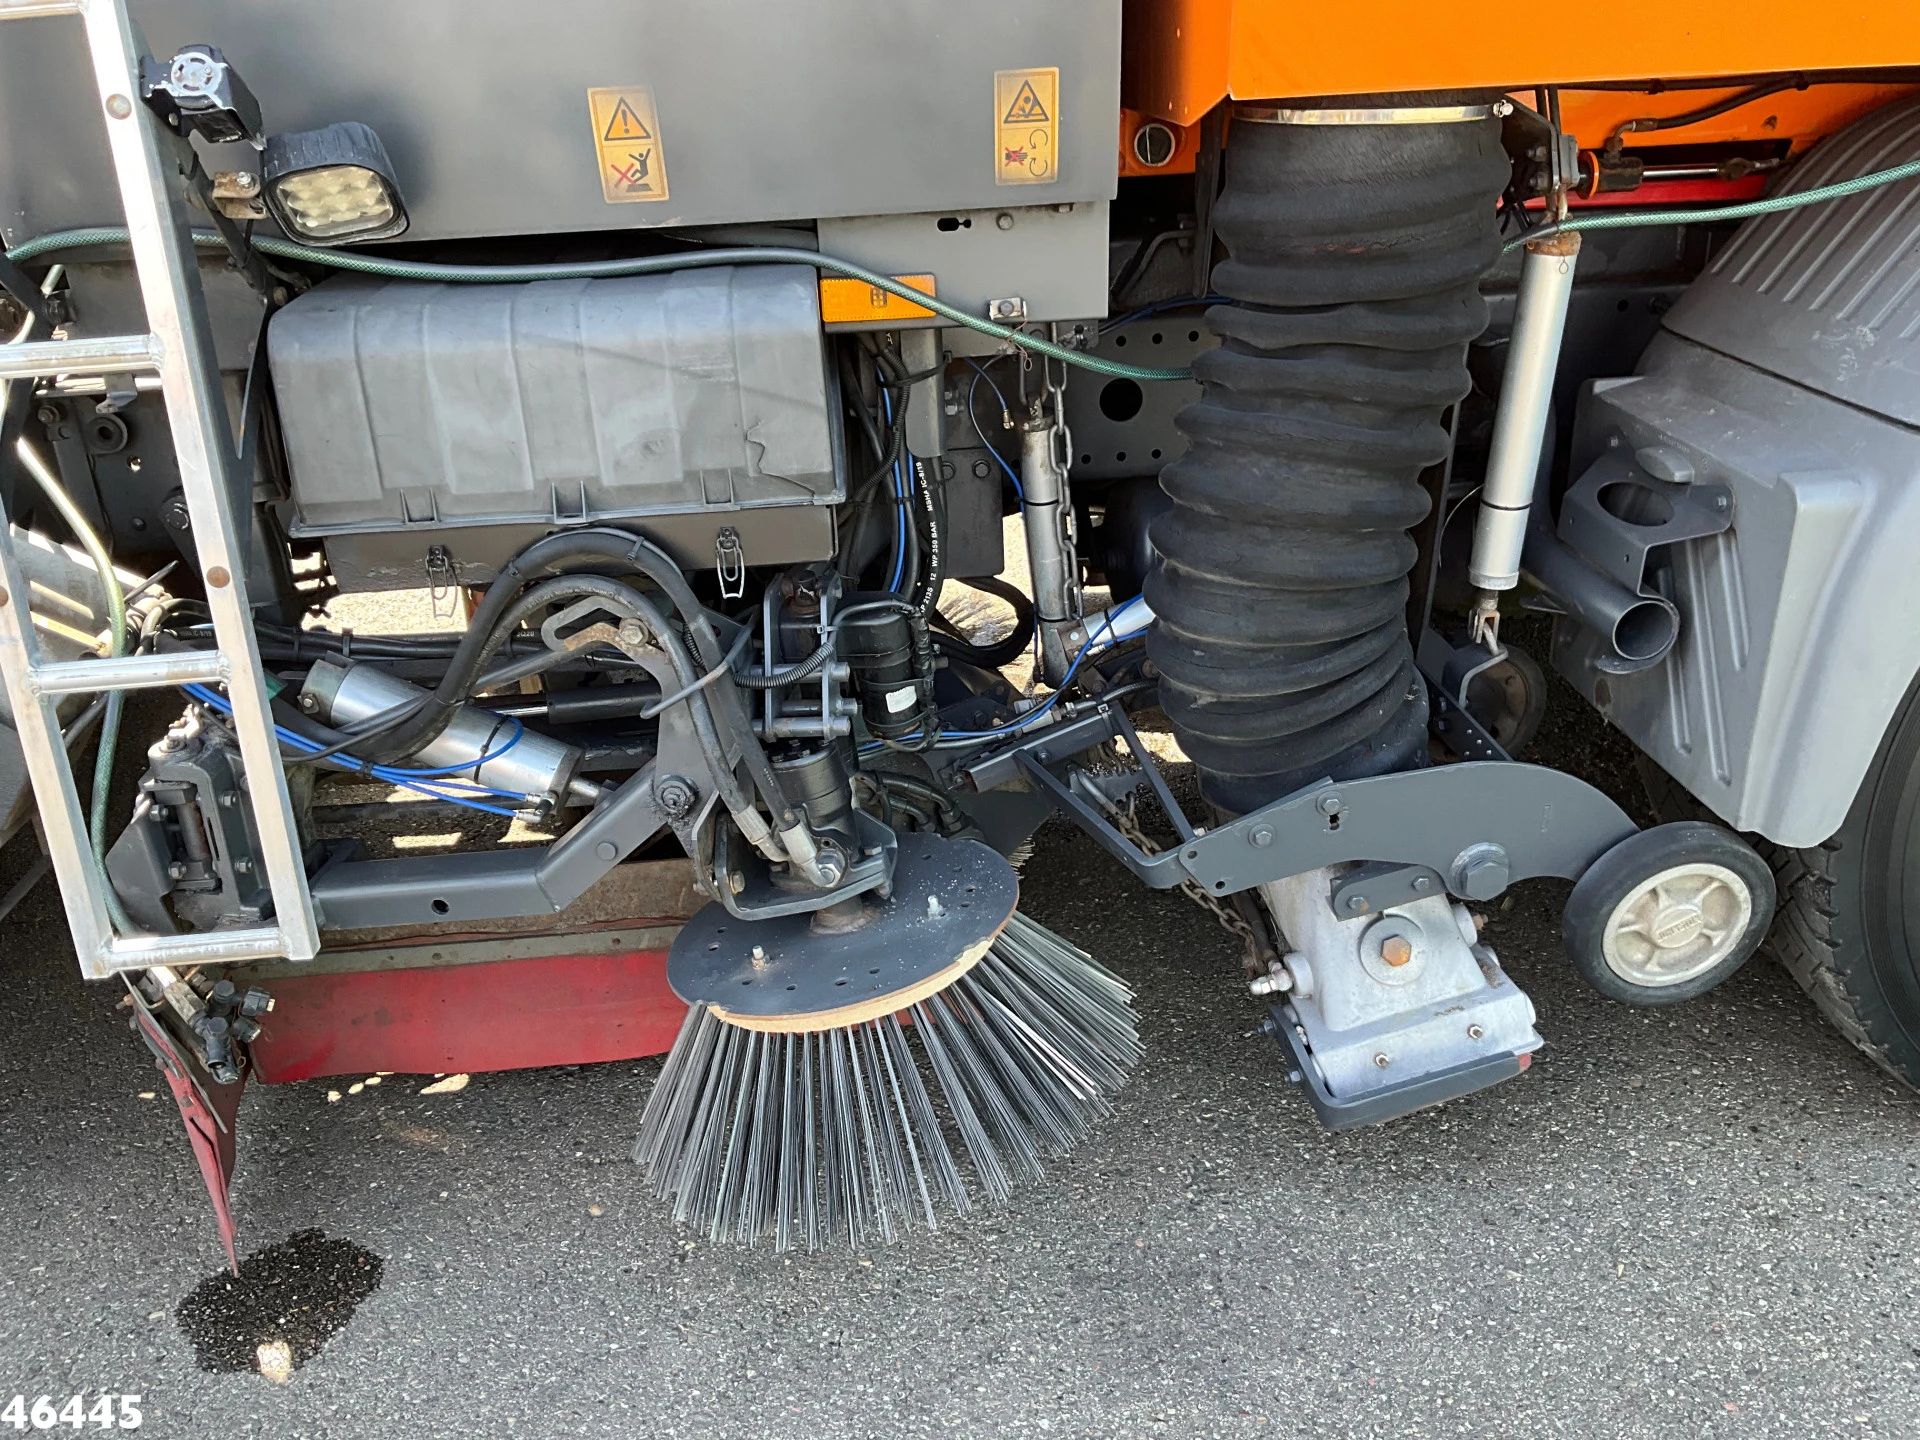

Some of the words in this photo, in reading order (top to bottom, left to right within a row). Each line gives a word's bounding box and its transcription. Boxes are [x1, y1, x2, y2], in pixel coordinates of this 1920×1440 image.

[923, 490, 933, 512] MSHA
[930, 521, 938, 538] BAR
[932, 554, 938, 567] WP
[930, 573, 936, 581] 12
[924, 588, 933, 604] 213S
